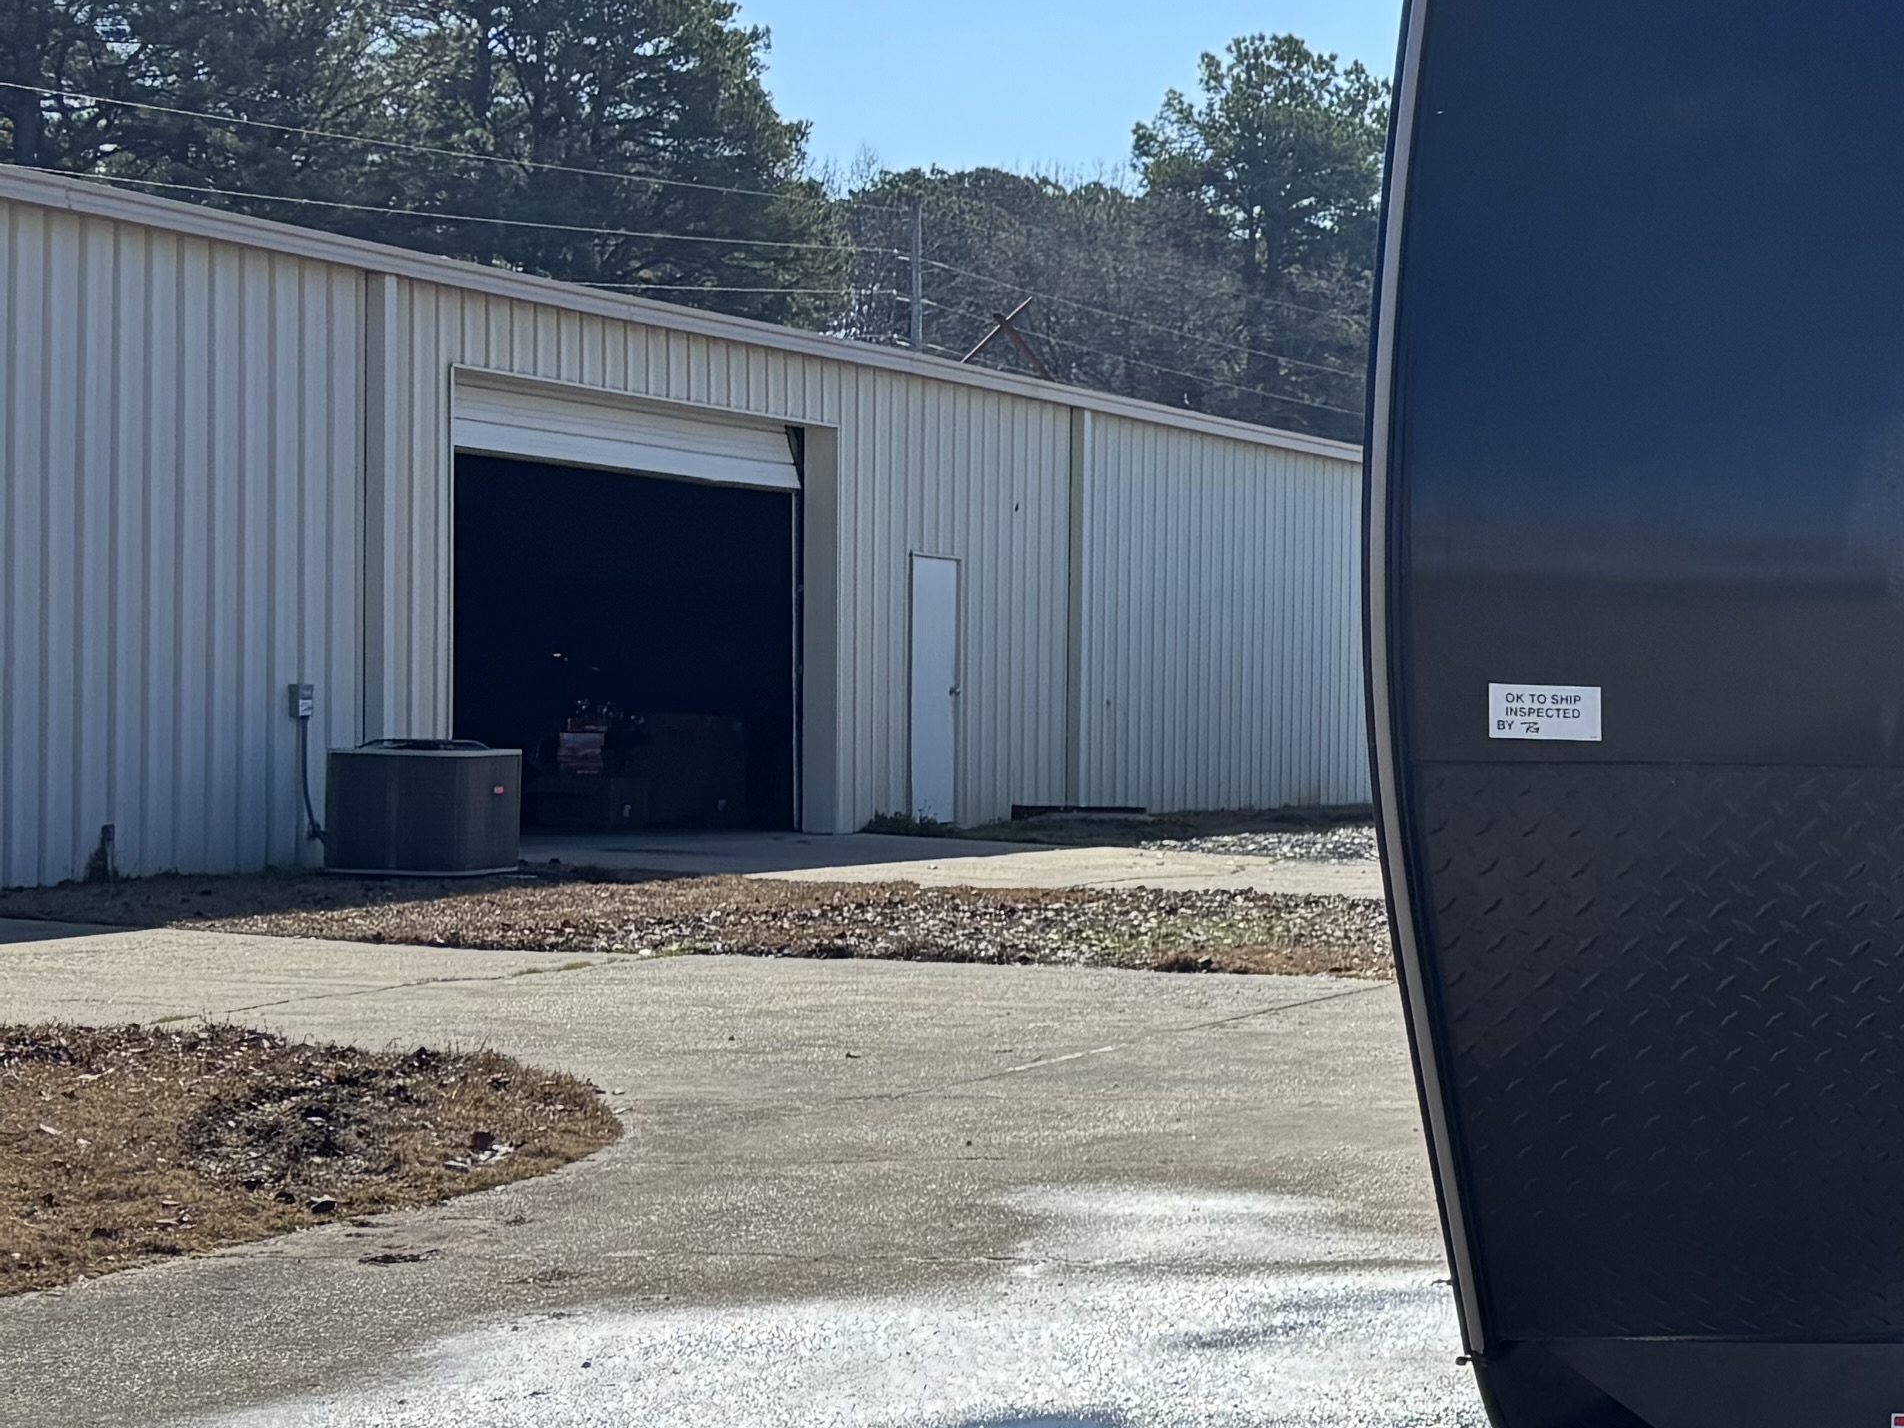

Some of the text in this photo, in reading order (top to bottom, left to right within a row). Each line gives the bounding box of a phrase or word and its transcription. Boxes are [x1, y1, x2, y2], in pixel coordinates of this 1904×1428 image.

[1505, 692, 1581, 705] OK TO SHIP
[1505, 706, 1581, 719] INSPECTED
[1497, 719, 1515, 730] BY
